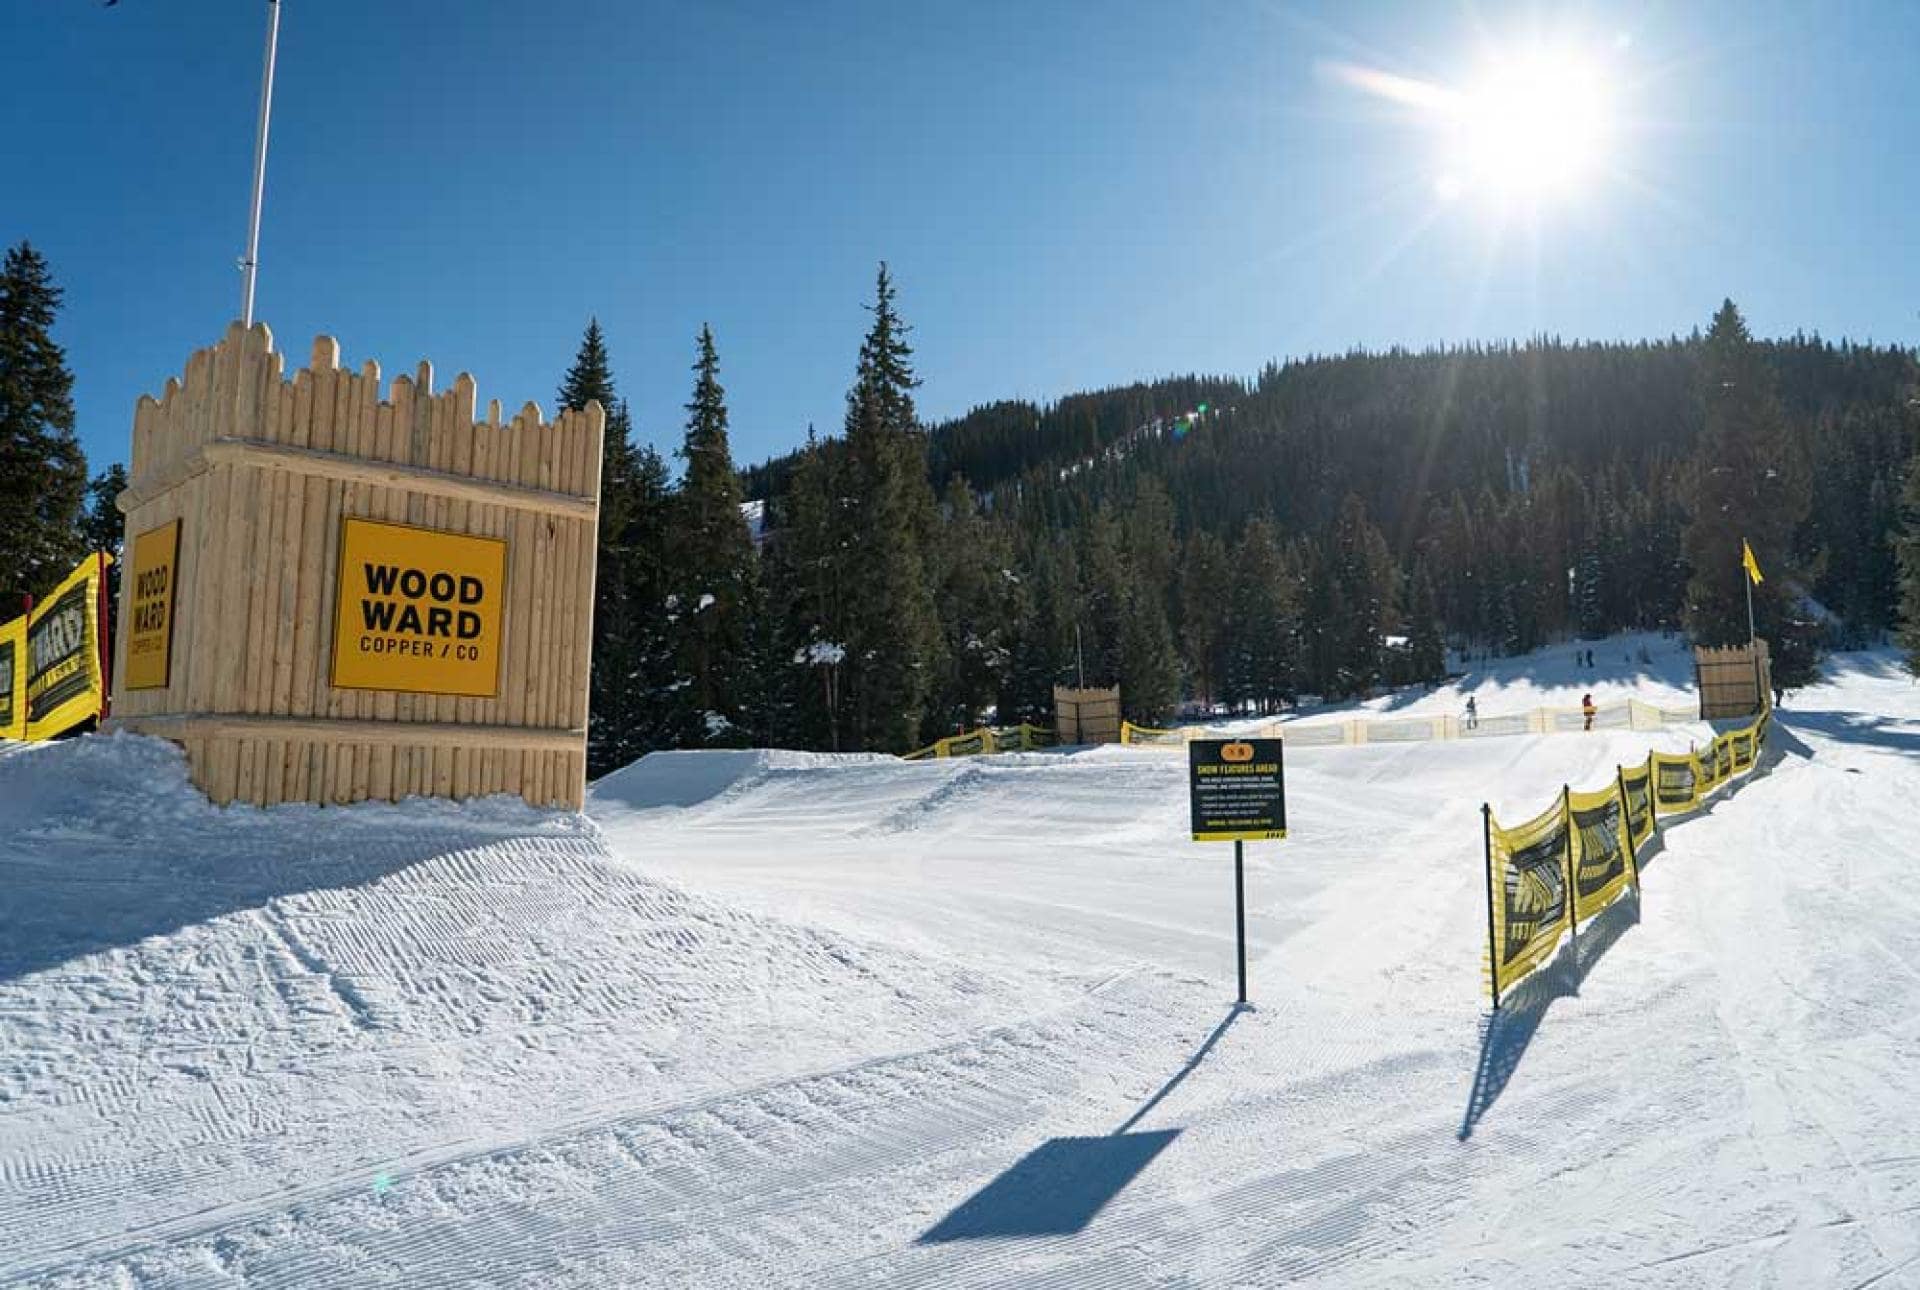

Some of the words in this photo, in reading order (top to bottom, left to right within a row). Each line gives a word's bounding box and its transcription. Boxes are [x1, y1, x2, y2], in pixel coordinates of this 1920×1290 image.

[137, 564, 168, 600] WOOD
[364, 563, 484, 605] WOOD
[134, 600, 165, 634] WARD
[362, 599, 481, 640] WARD
[360, 635, 433, 659] COPPER
[456, 644, 479, 661] CO
